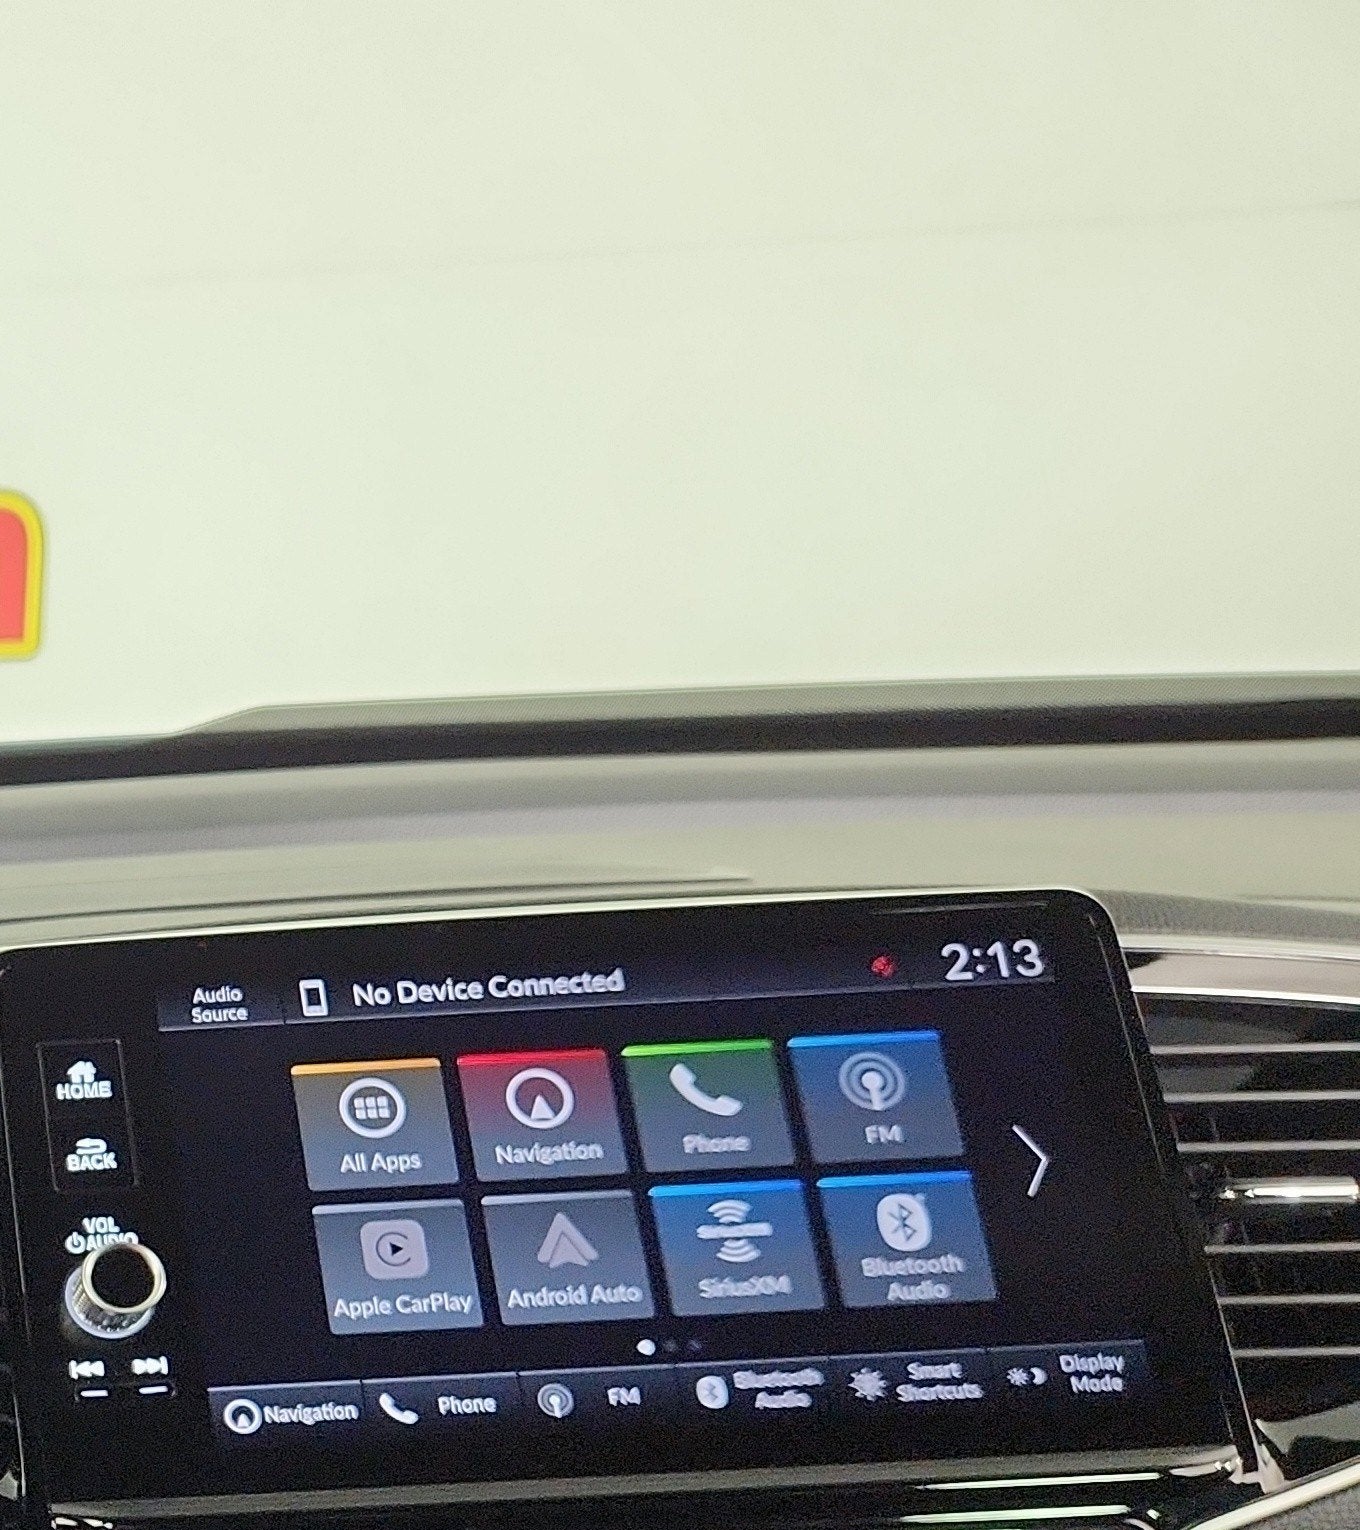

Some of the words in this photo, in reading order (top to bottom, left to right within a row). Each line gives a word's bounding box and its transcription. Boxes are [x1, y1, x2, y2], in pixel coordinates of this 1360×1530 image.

[941, 937, 1046, 983] 2:13
[192, 986, 243, 1005] Audio
[353, 981, 392, 1007] No
[396, 976, 485, 1004] Device
[488, 967, 626, 999] Connected
[191, 1004, 248, 1025] Source
[56, 1080, 113, 1100] HOME
[683, 1131, 750, 1155] Phone
[865, 1124, 903, 1145] FM
[66, 1152, 118, 1172] BACK
[340, 1152, 367, 1174] All
[371, 1151, 423, 1175] Apps
[495, 1140, 604, 1168] Navigation
[82, 1216, 121, 1234] VOL
[861, 1254, 966, 1278] Bluetooth
[507, 1285, 588, 1310] Android
[590, 1283, 643, 1304] Auto
[887, 1280, 950, 1301] Audio
[334, 1297, 390, 1320] Apple
[396, 1291, 473, 1315] CarPlay
[1059, 1353, 1126, 1376] Display
[1070, 1374, 1126, 1393] Mode
[438, 1393, 497, 1416] Phone
[607, 1387, 641, 1405] FM
[263, 1401, 360, 1426] Navigation
